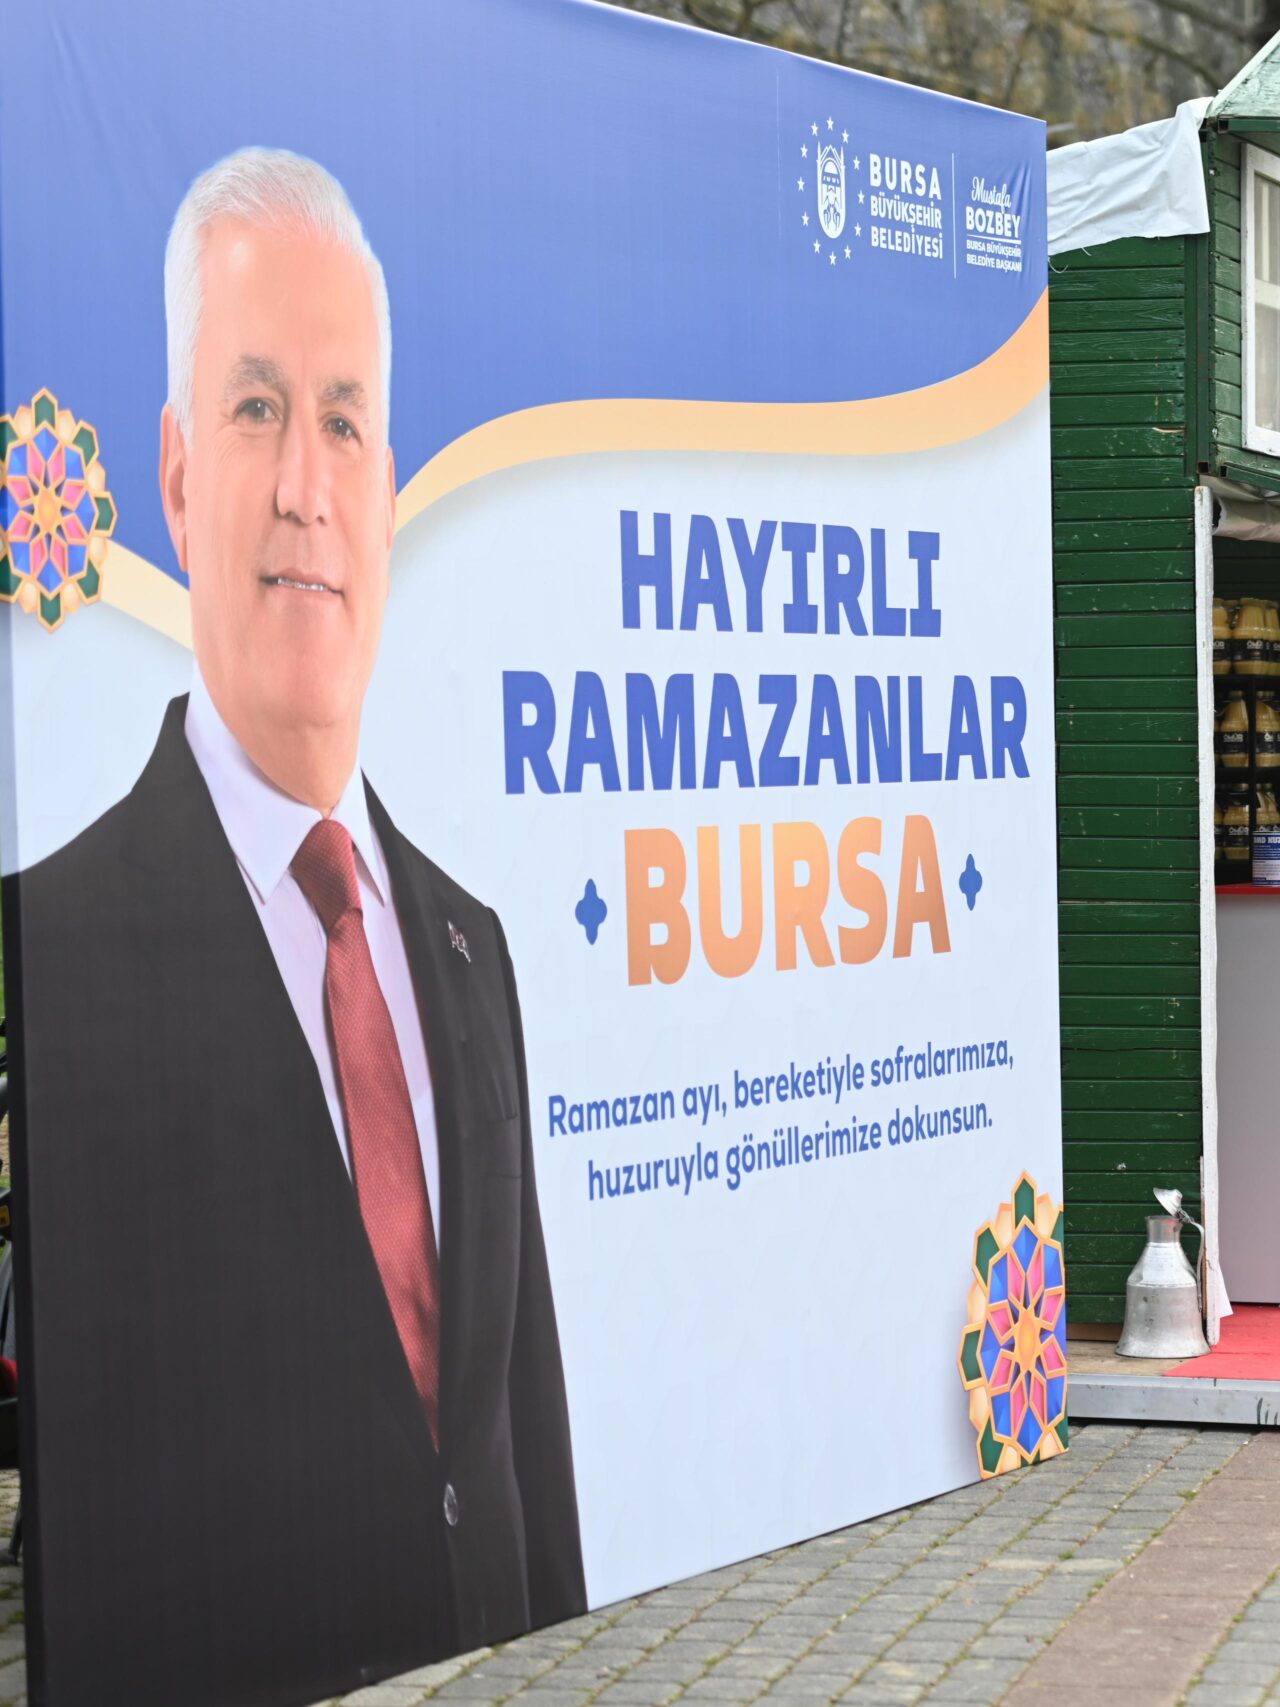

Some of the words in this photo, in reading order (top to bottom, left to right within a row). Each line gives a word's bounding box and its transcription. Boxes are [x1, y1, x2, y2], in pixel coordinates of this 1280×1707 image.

[869, 153, 942, 200] BURSA
[971, 176, 1012, 214] Mustafa
[870, 191, 942, 230] BÜYÜKŞEHİR
[965, 206, 1021, 239] BOZBEY
[871, 225, 943, 259] BELEDİYESİ
[966, 239, 986, 252] BURSA
[986, 241, 1022, 258] BÜYÜKŞEHİR
[966, 253, 995, 269] BELEDİYE
[995, 258, 1022, 273] BAŞKANI
[620, 510, 941, 638] HAYIRLI
[502, 670, 1031, 795] RAMAZANLAR
[624, 814, 952, 987] BURSA
[548, 1094, 676, 1137] Ramazan
[682, 1084, 727, 1126] ayı,
[734, 1053, 865, 1104] bereketiyle
[871, 1039, 1014, 1087] sofralarımıza,
[587, 1142, 719, 1201] huzuruyla
[726, 1115, 882, 1191] gönüllerimize
[888, 1102, 993, 1146] dokunsun.
